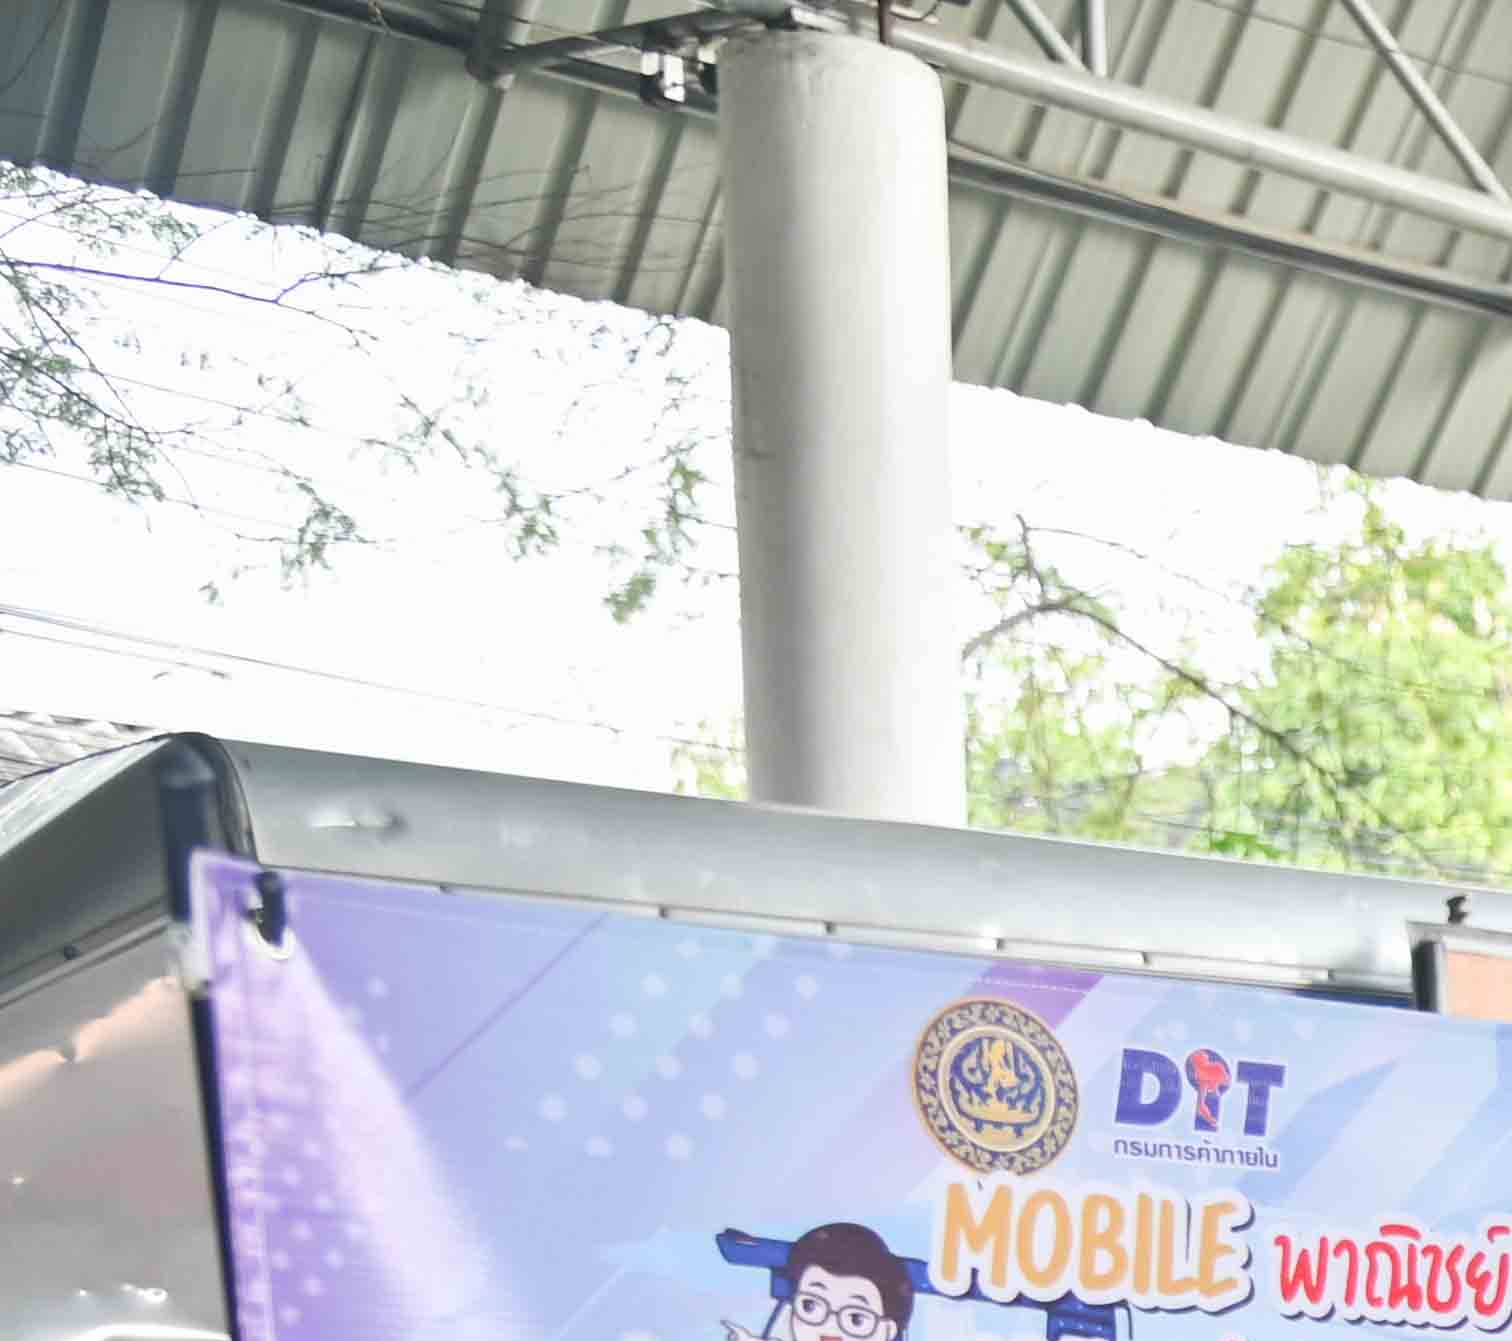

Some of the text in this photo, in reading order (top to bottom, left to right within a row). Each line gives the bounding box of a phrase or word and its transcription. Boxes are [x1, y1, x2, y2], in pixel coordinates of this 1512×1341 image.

[1114, 1137, 1279, 1169] กรมการค้าภายใน
[941, 1182, 1512, 1317] MOBILE พาณิชย์
